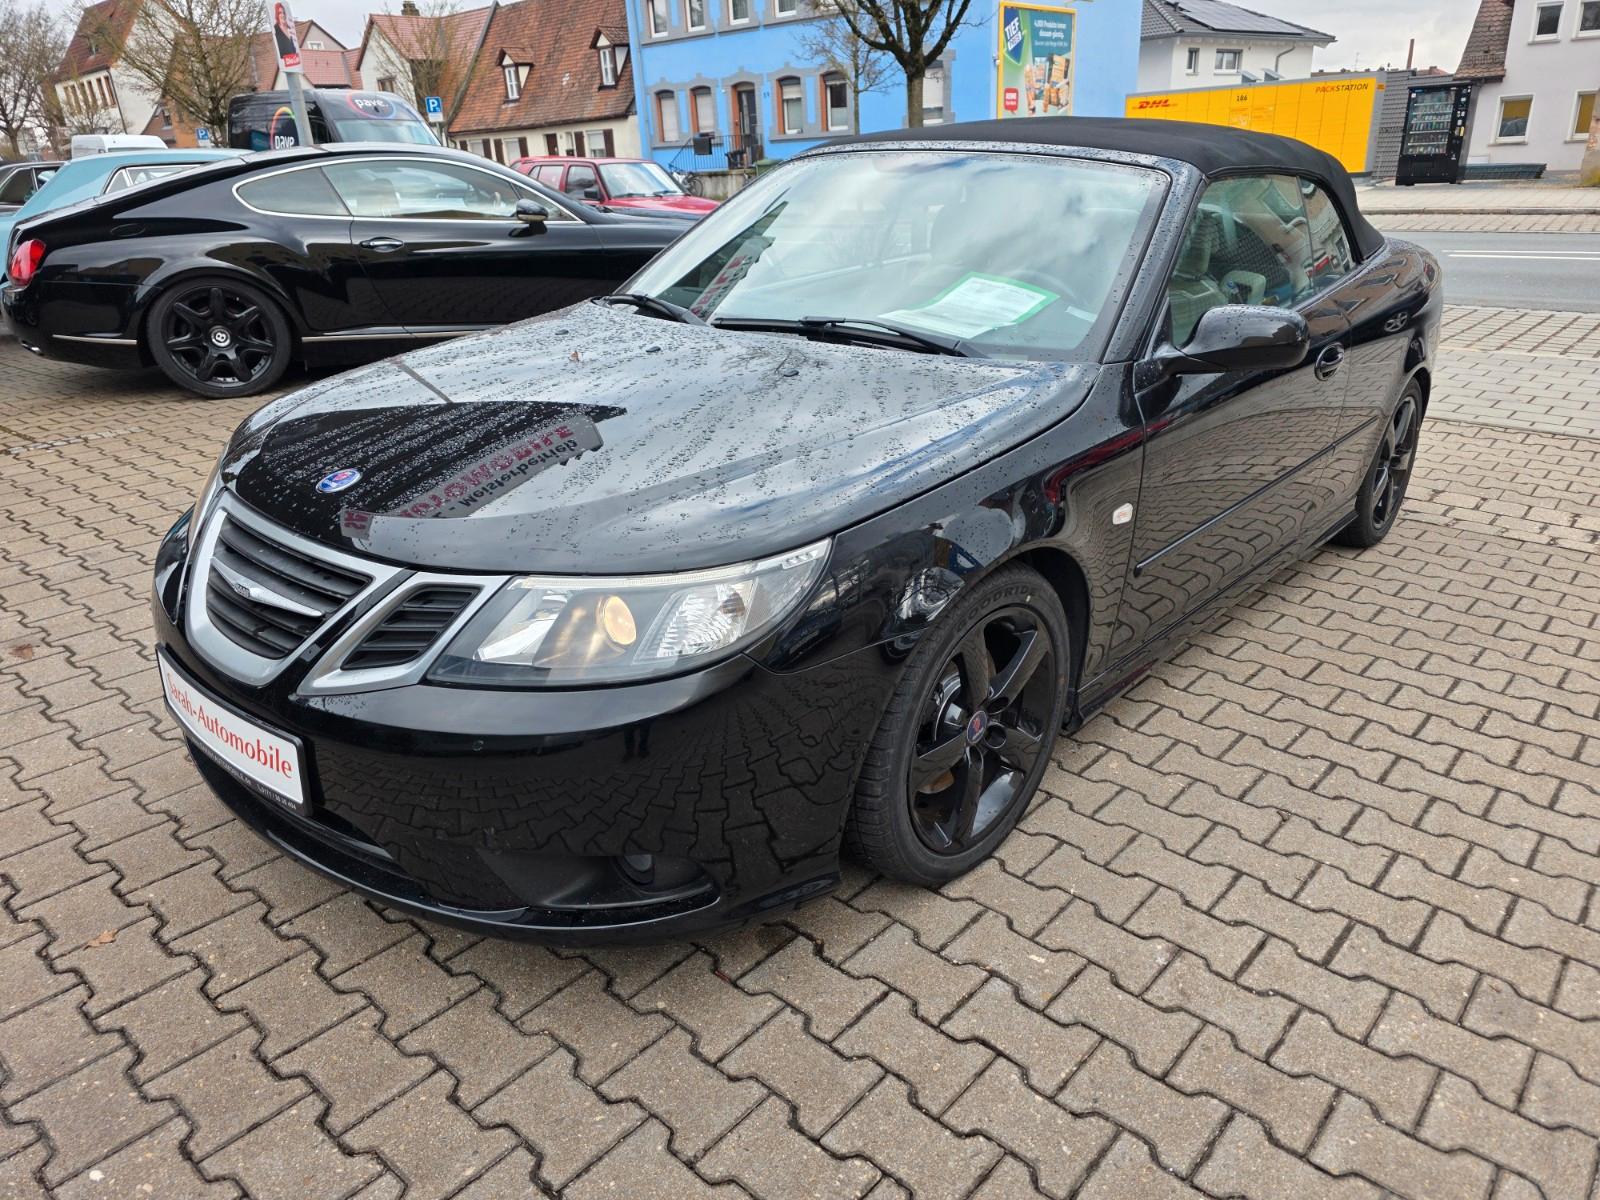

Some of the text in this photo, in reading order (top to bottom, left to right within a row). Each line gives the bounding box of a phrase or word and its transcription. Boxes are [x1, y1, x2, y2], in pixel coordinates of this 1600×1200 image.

[1315, 83, 1369, 94] PACKSTATION
[429, 99, 438, 112] P
[1138, 99, 1170, 110] DHL
